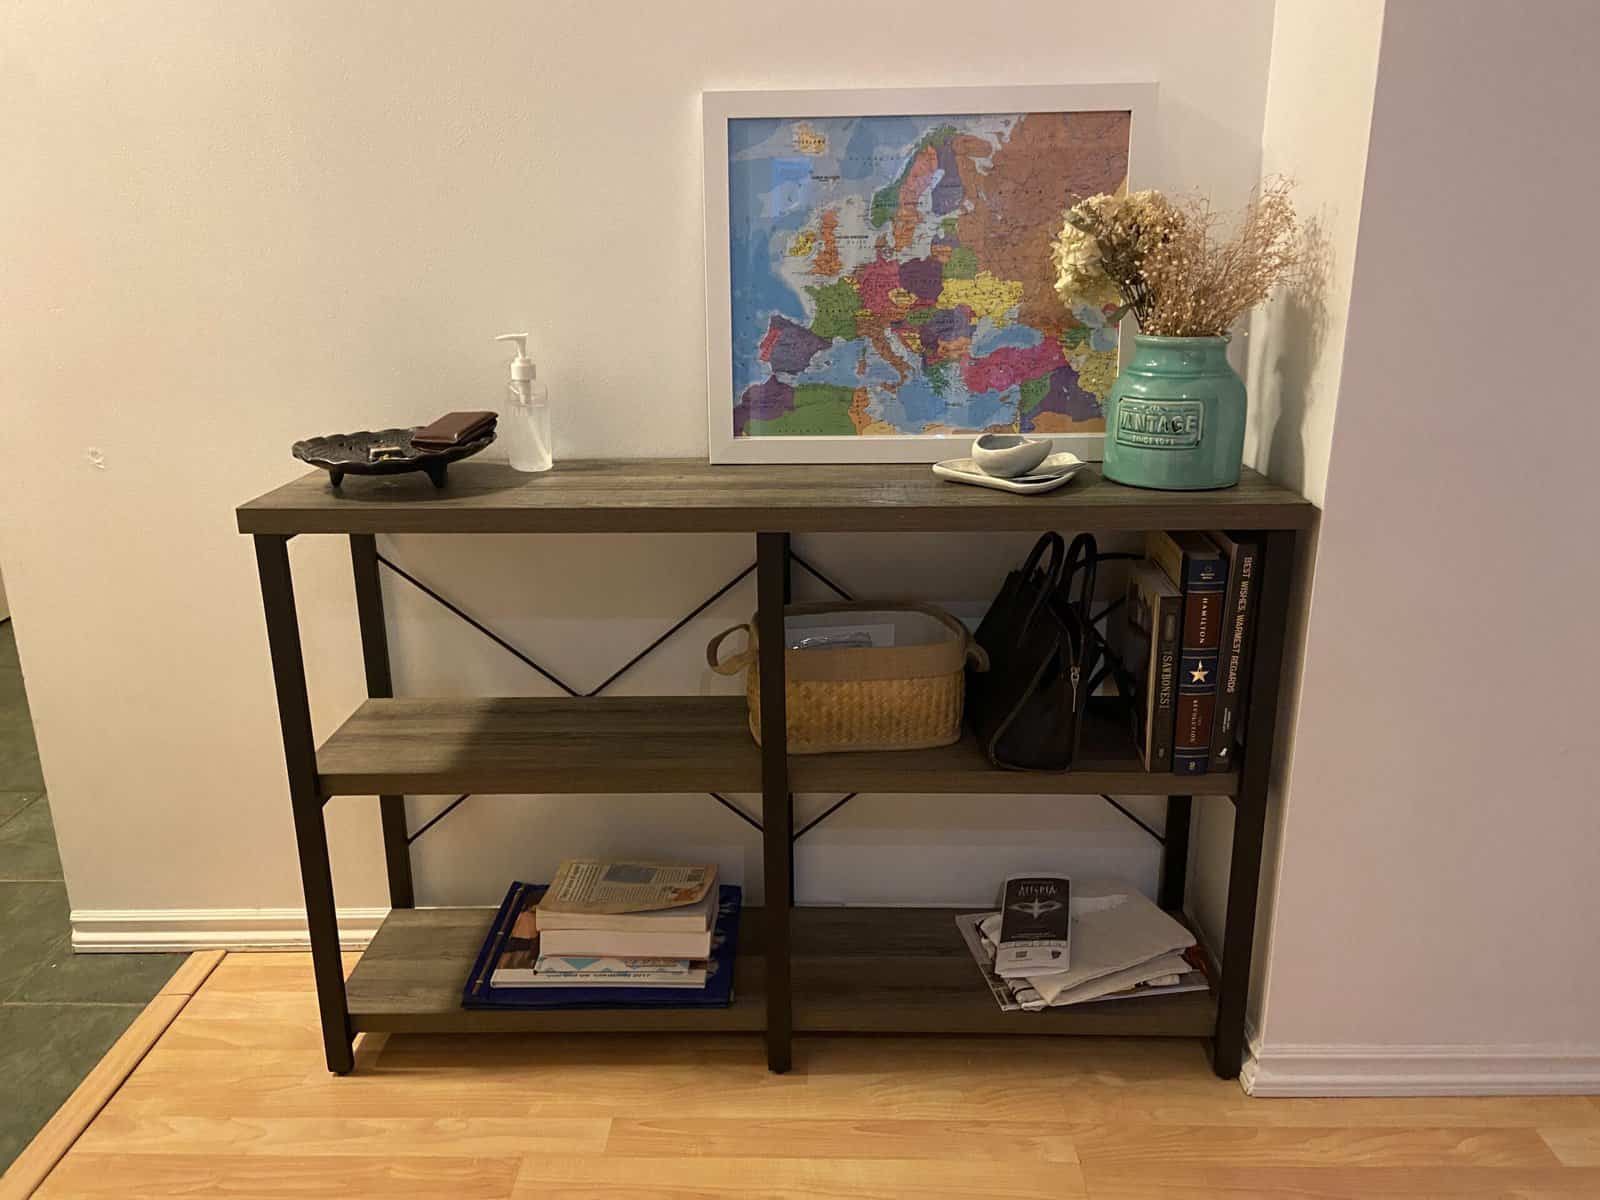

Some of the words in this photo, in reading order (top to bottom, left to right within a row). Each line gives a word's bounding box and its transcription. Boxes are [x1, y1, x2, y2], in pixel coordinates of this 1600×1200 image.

[1243, 556, 1253, 577] BEST
[1200, 598, 1209, 644] HAMILTON
[1231, 614, 1245, 652] WARMEST
[1226, 655, 1239, 693] REGARDS
